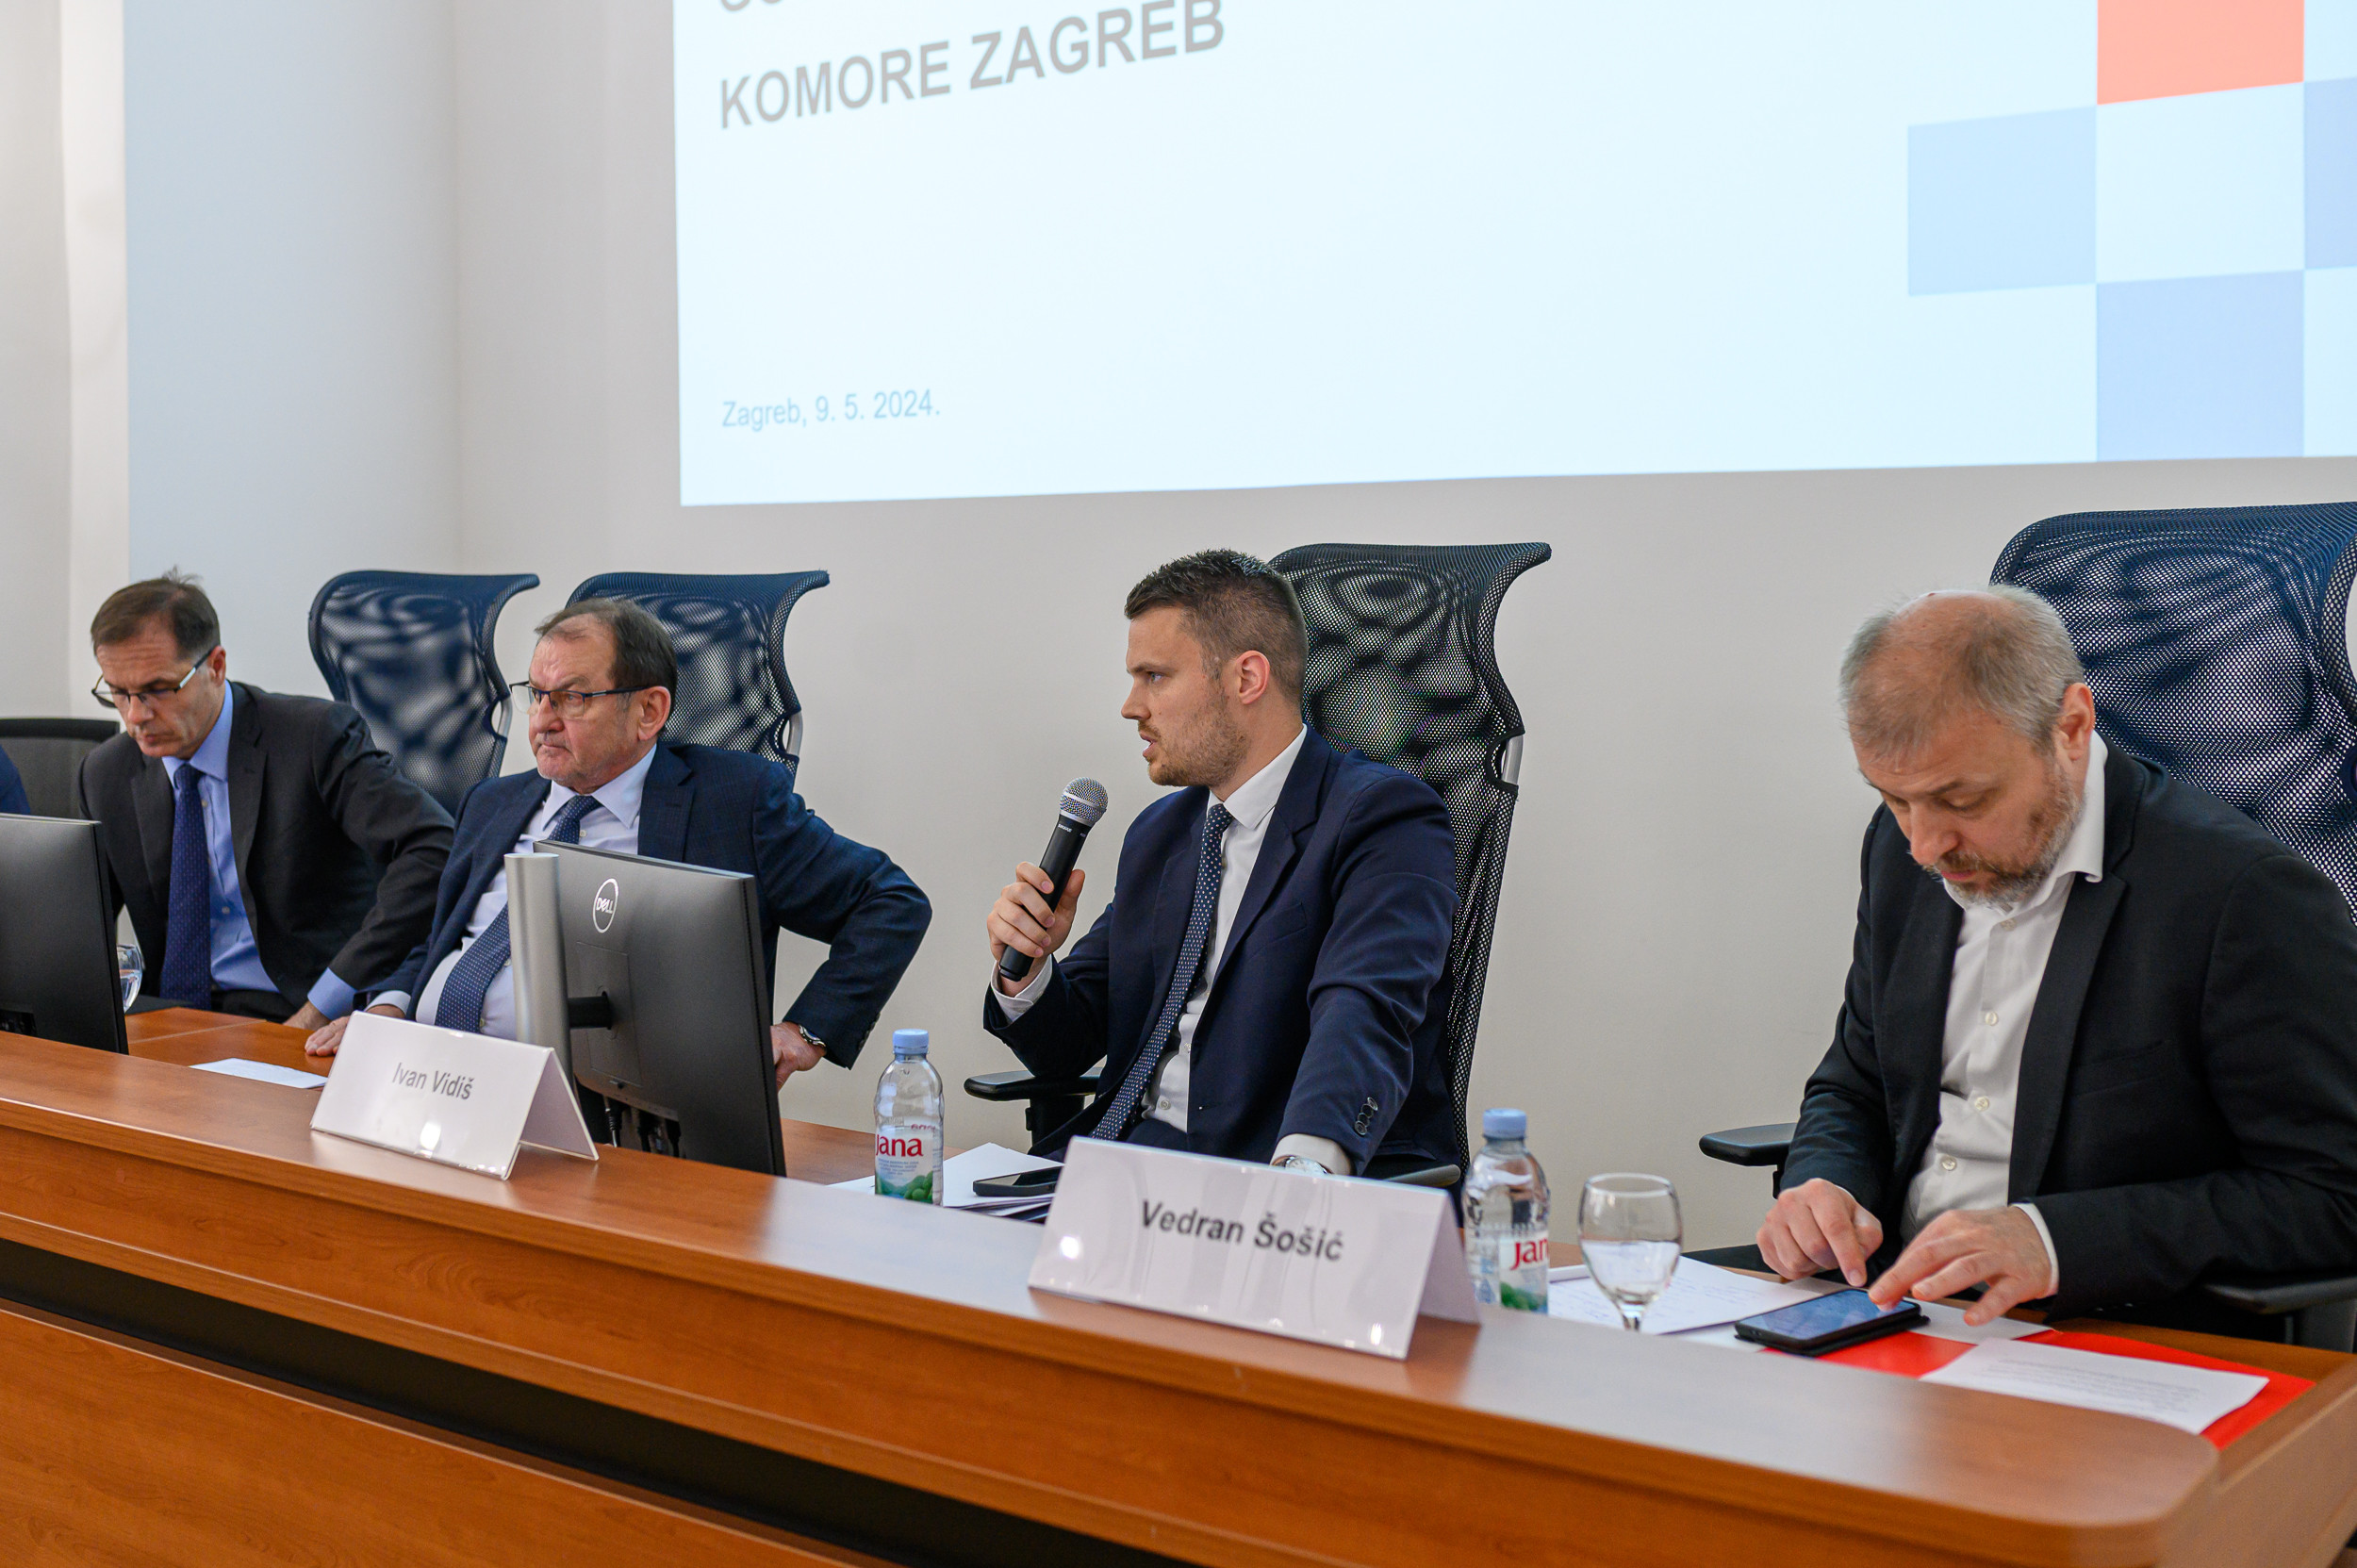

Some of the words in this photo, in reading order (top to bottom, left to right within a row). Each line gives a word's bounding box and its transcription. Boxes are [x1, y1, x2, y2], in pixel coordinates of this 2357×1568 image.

[721, 41, 950, 129] KOMORE
[969, 0, 1225, 90] ZAGREB
[722, 396, 808, 433] Zagreb,
[815, 395, 836, 422] 9.
[845, 393, 865, 421] 5.
[873, 388, 941, 419] 2024.
[596, 897, 614, 914] DELL
[392, 1062, 428, 1090] Ivan
[432, 1070, 475, 1100] Vidiš
[875, 1134, 924, 1158] Jana
[1141, 1198, 1244, 1246] Vedran
[1253, 1211, 1344, 1263] Šošić
